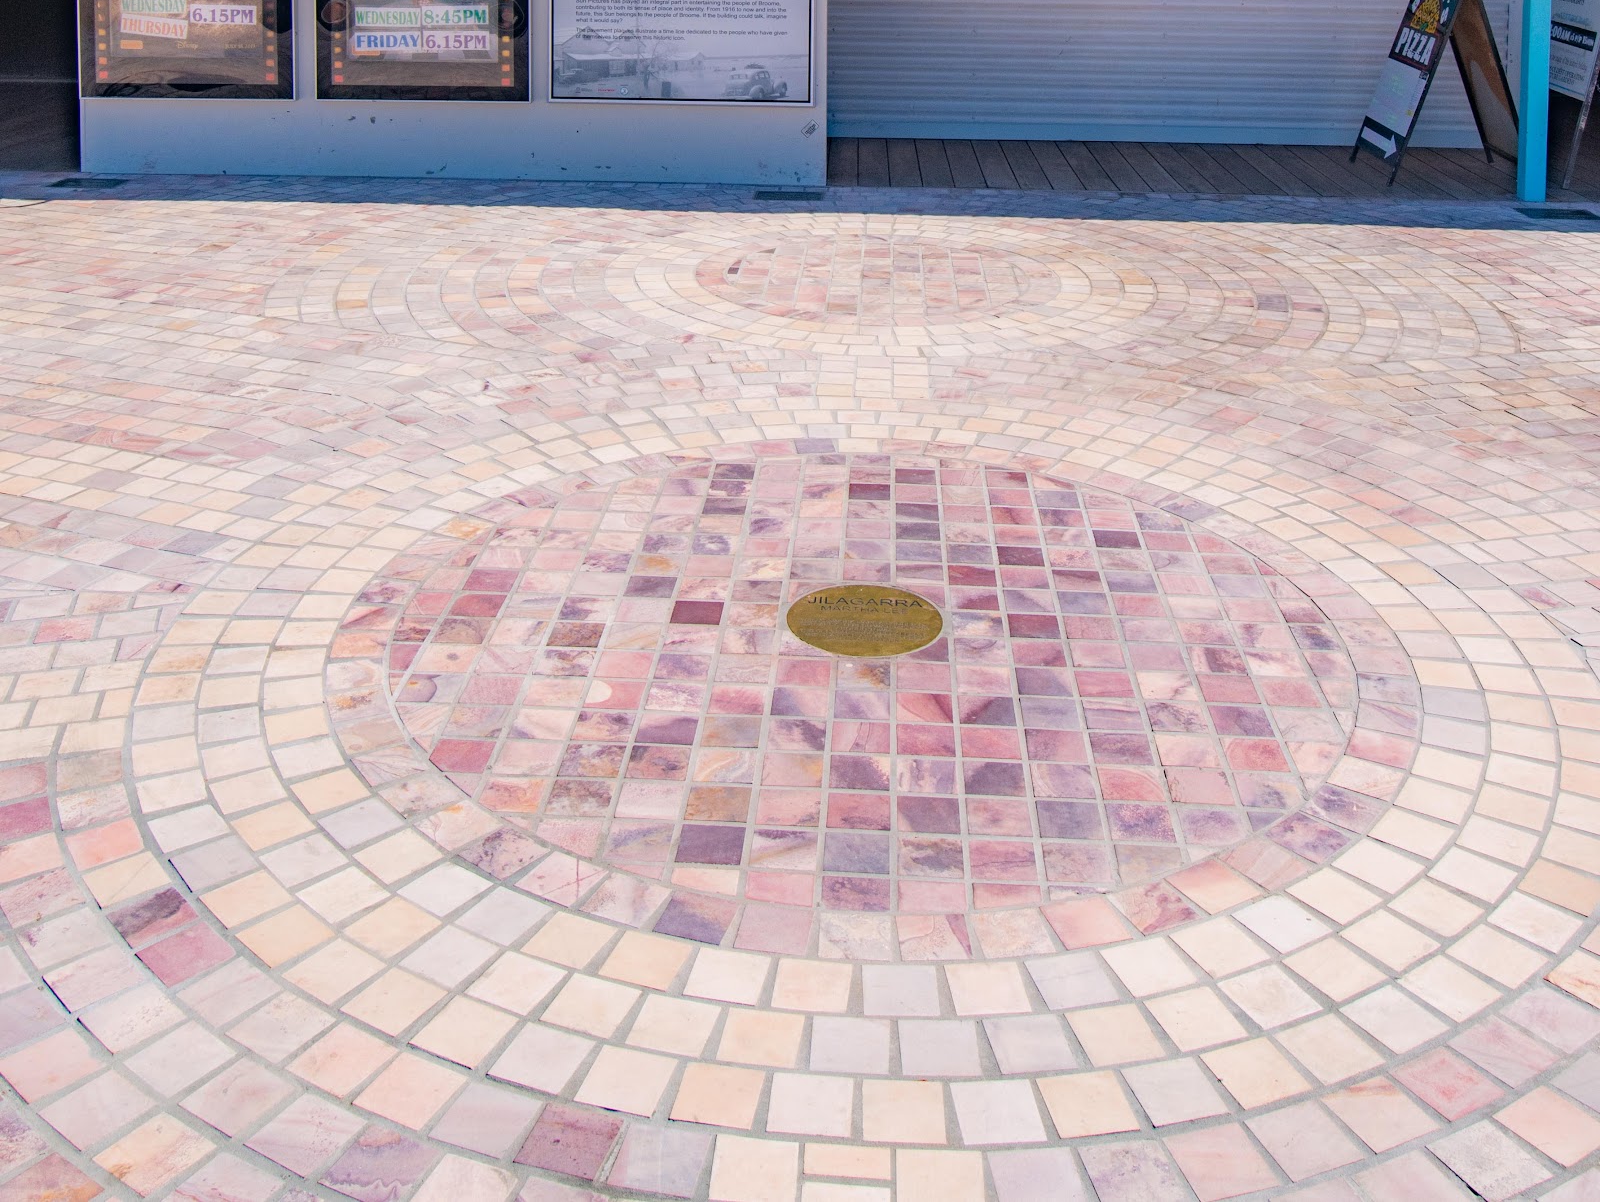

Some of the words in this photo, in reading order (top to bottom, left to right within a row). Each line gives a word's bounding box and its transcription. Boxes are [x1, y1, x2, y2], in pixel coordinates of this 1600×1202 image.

[192, 8, 254, 24] 6.15PM
[356, 10, 420, 25] WEDNESDAY
[424, 9, 487, 24] 8:45PM
[122, 18, 186, 37] THURSDAY
[356, 35, 420, 48] FRIDAY
[426, 35, 487, 48] 6.15PM
[1395, 27, 1436, 65] PIZZA
[808, 596, 923, 608] JILAGARRA
